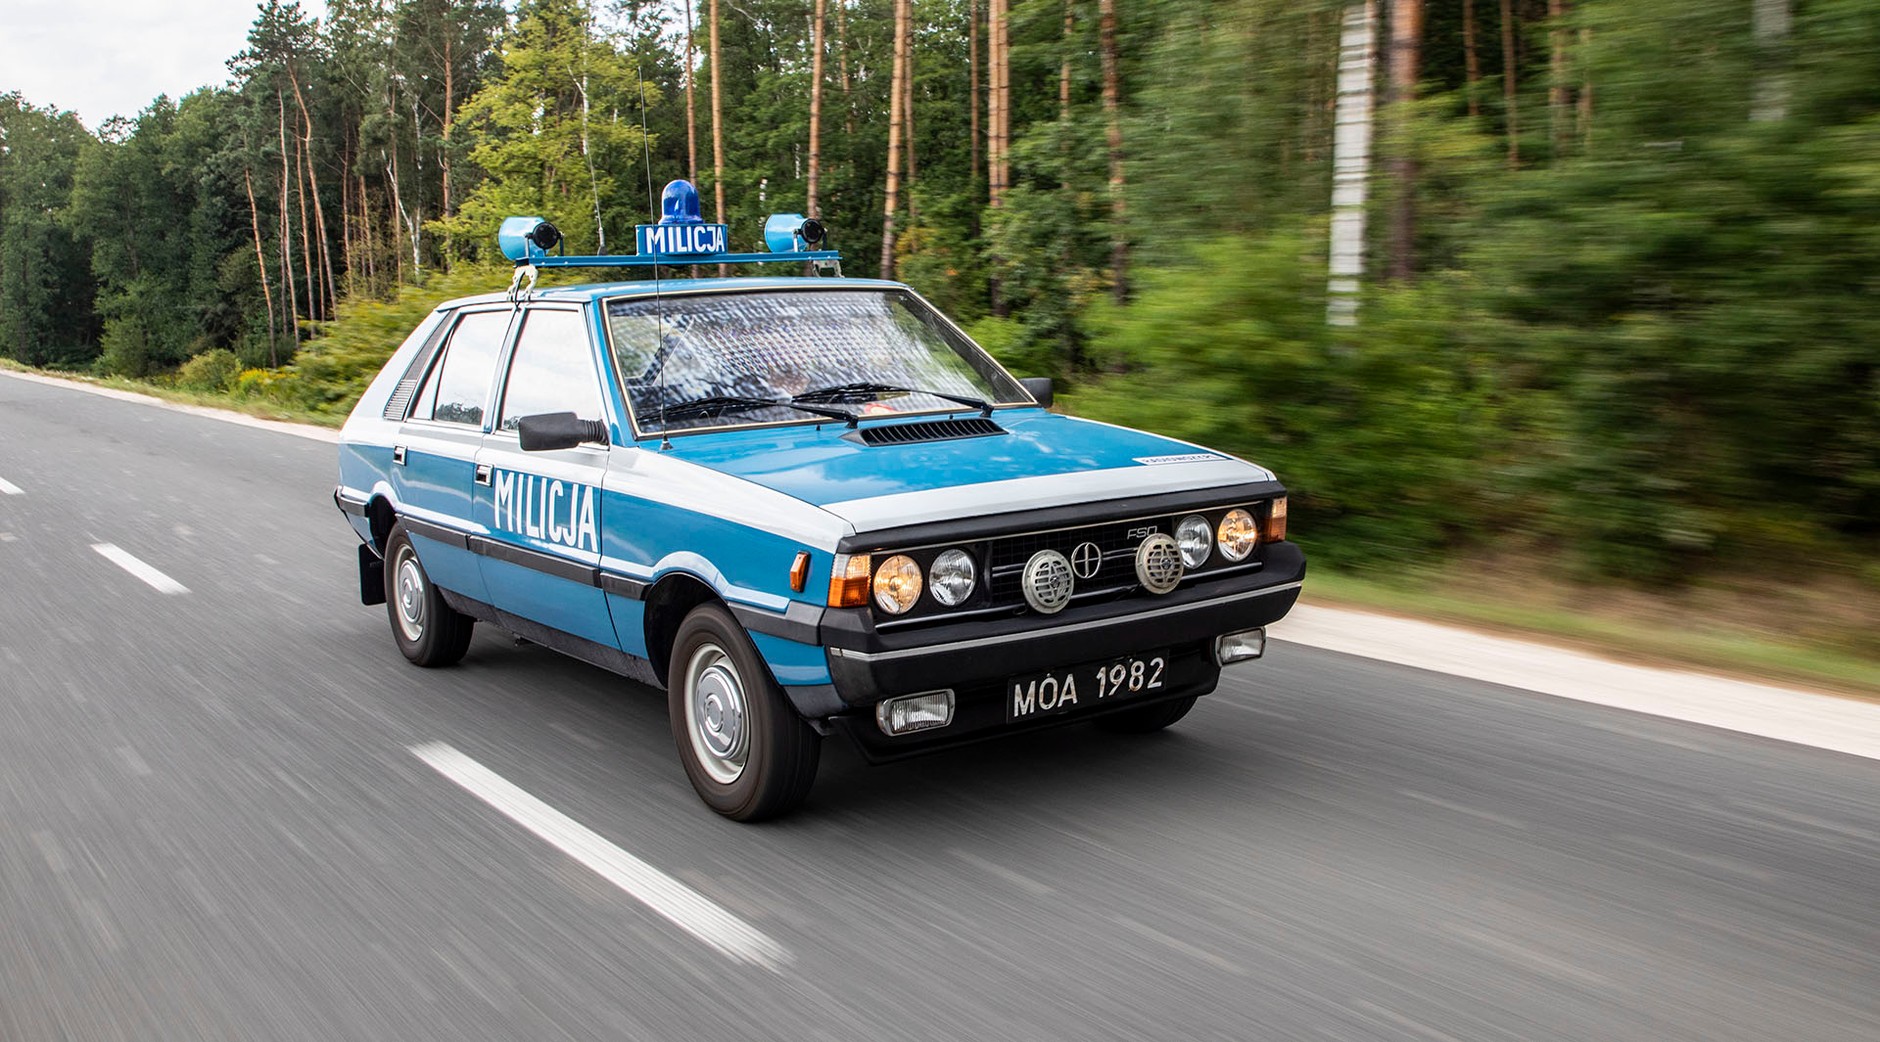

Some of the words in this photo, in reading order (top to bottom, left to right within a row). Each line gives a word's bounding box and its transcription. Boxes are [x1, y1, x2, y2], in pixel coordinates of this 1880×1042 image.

[645, 226, 725, 254] MILICJA
[494, 469, 598, 553] MILICJA
[1014, 673, 1078, 717] MOA
[1096, 657, 1165, 698] 1982
